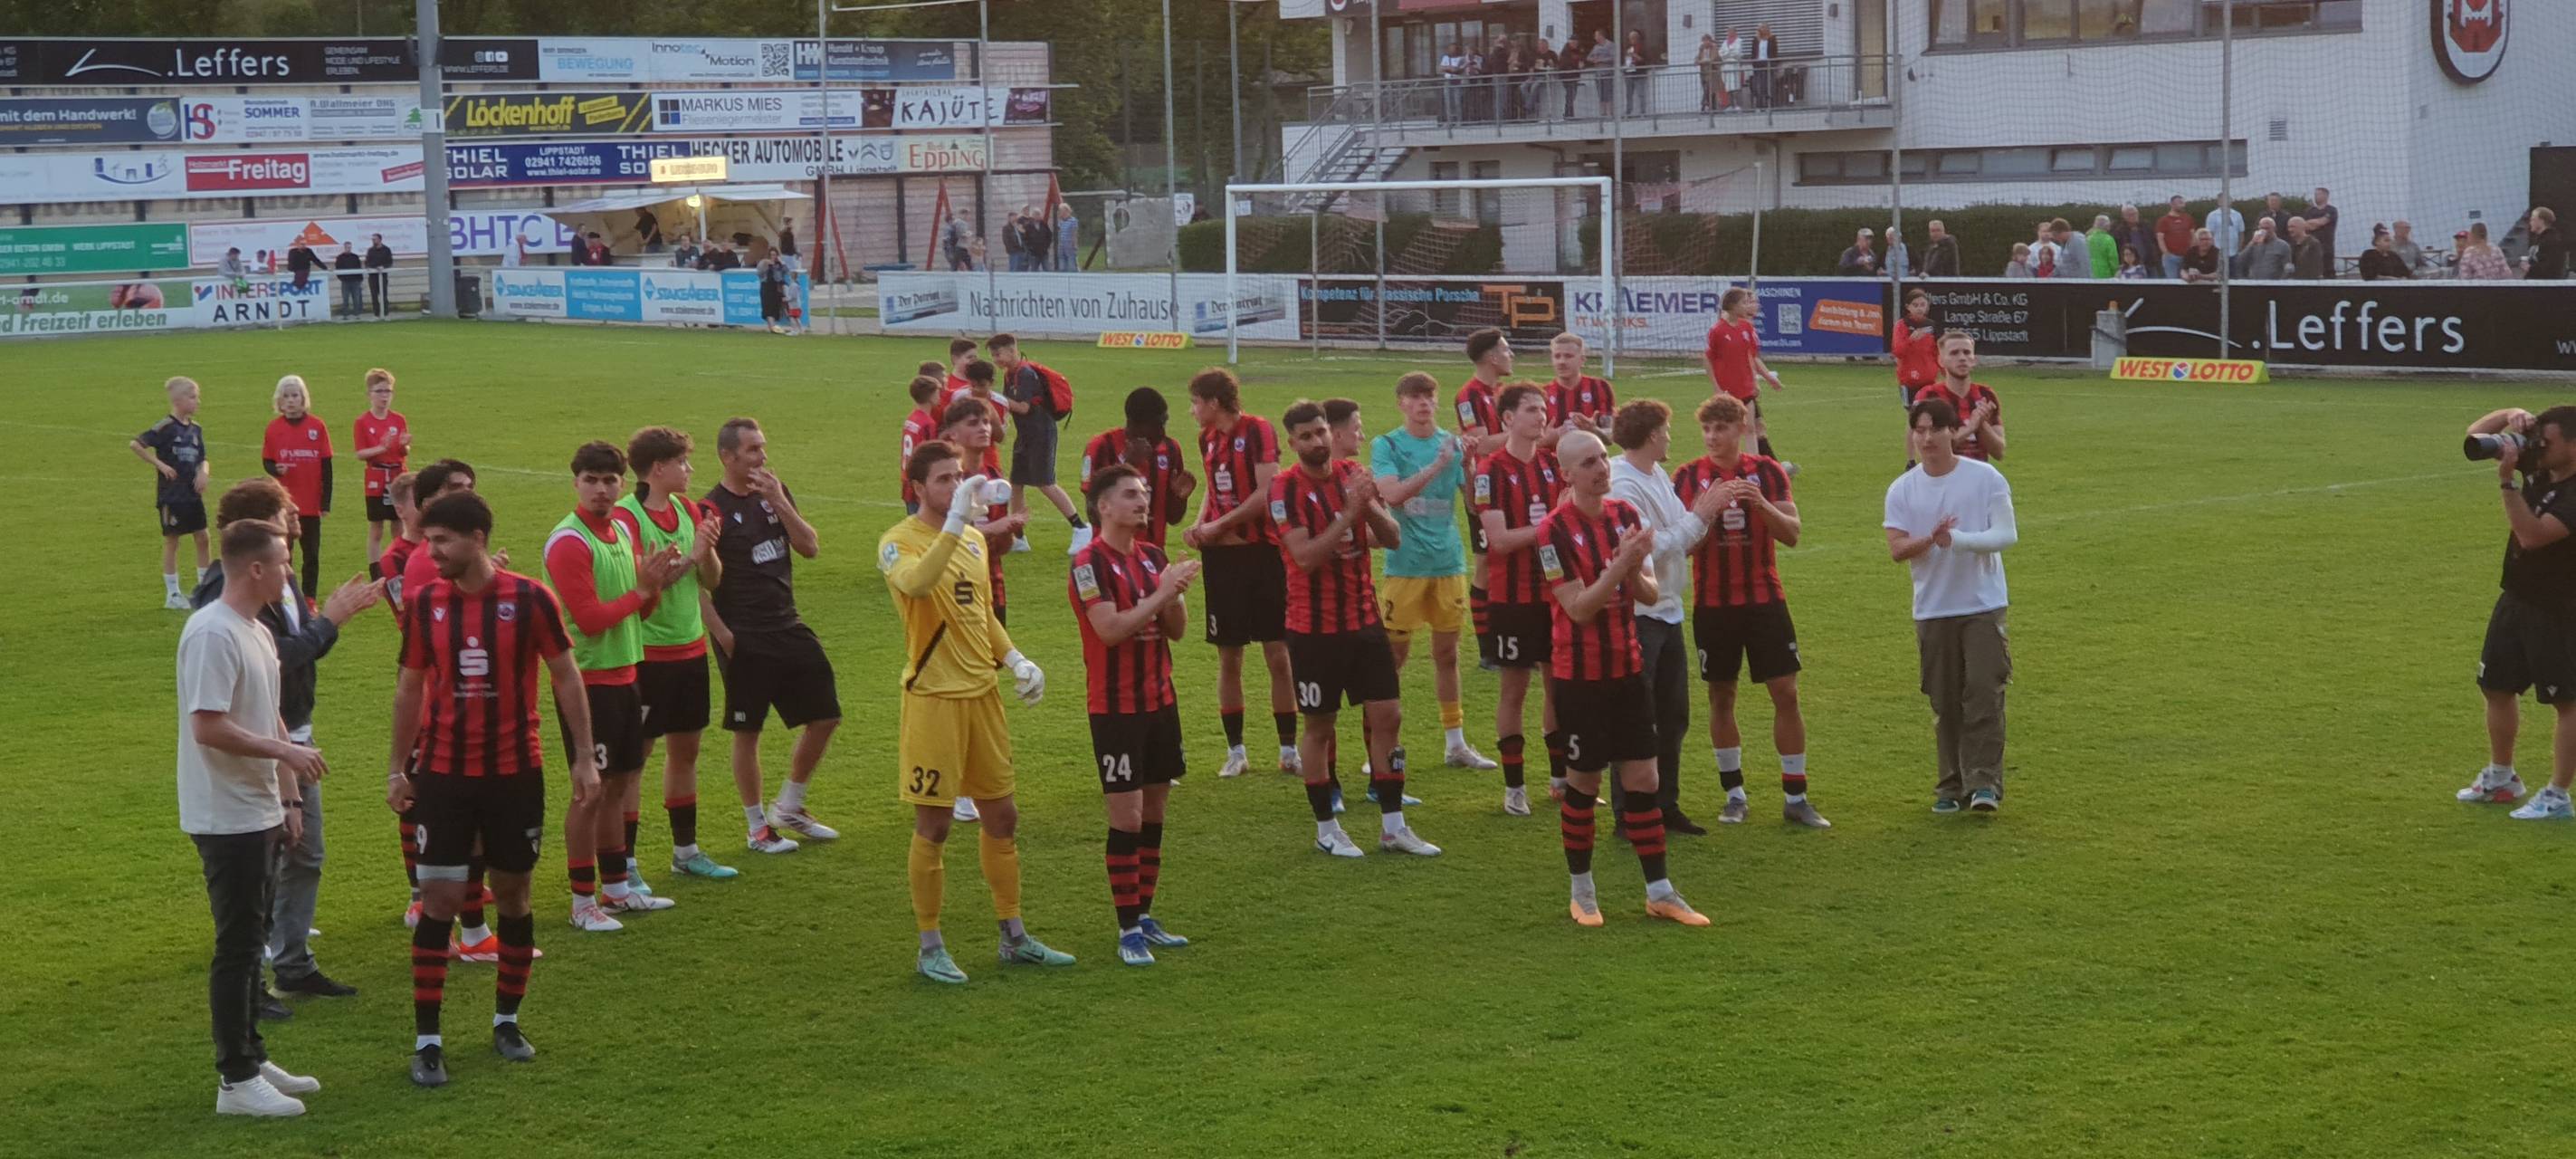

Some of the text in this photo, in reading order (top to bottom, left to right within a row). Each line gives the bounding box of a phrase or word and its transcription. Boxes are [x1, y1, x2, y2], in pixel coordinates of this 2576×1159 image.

[558, 58, 633, 70] BEWEGUNG
[710, 56, 755, 66] Motion
[24, 109, 56, 121] dem
[59, 108, 137, 121] Handwerk!
[244, 107, 301, 119] SOMMER
[466, 96, 576, 127] Löckenhoff
[682, 97, 782, 111] MARKUS MIES
[901, 95, 999, 125] KAJÜTE
[539, 147, 586, 156] LIPPSTADT
[617, 145, 683, 159] THIEL
[228, 158, 306, 183] Freitag
[525, 158, 556, 168] 02941
[1070, 296, 1102, 318] von
[1106, 291, 1180, 321] Zuhause
[1948, 291, 1982, 305] GmbH
[1983, 292, 1991, 305] &
[1993, 292, 2009, 306] Co.
[2012, 292, 2028, 306] KG
[20, 311, 91, 332] Freizeit
[97, 310, 167, 329] erleben
[213, 299, 310, 322] ARNDT
[1944, 310, 2028, 326] Lange Straße 67
[1101, 332, 1183, 348] WEST LOTTO
[1982, 328, 2029, 343] Lippstadt
[2118, 359, 2255, 381] WEST LOTTO
[1209, 615, 1218, 637] 3
[1497, 635, 1519, 660] 15
[1298, 681, 1321, 708] 30
[594, 742, 608, 771] 3
[1567, 733, 1580, 761] 5
[1102, 753, 1132, 783] 24
[910, 767, 940, 796] 32
[416, 823, 428, 854] 9
